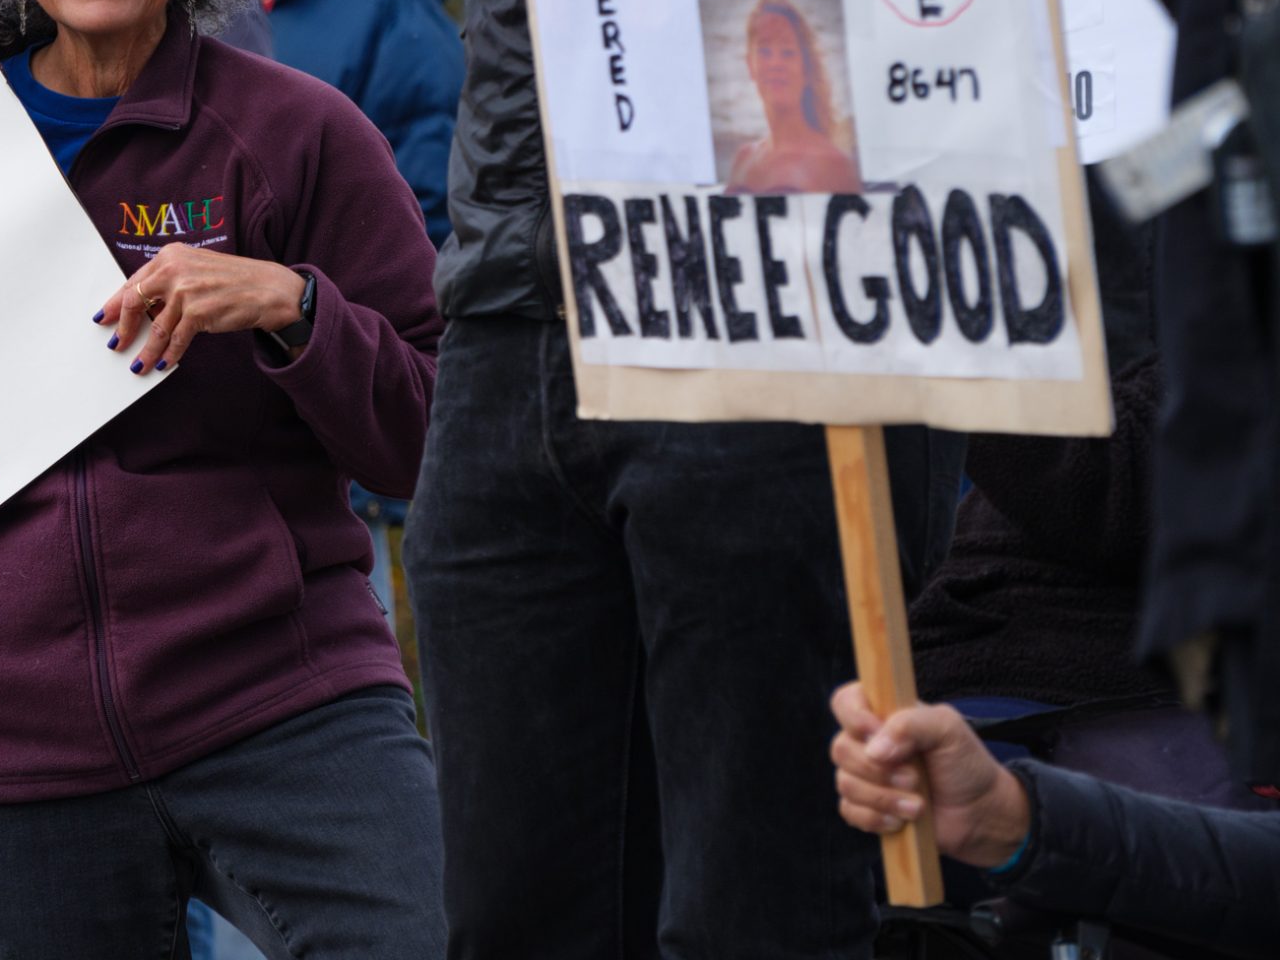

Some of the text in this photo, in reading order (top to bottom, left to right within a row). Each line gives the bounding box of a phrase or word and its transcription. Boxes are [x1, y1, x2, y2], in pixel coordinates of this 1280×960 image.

[886, 61, 980, 105] 8647
[561, 184, 1065, 347] RENEE GOOD
